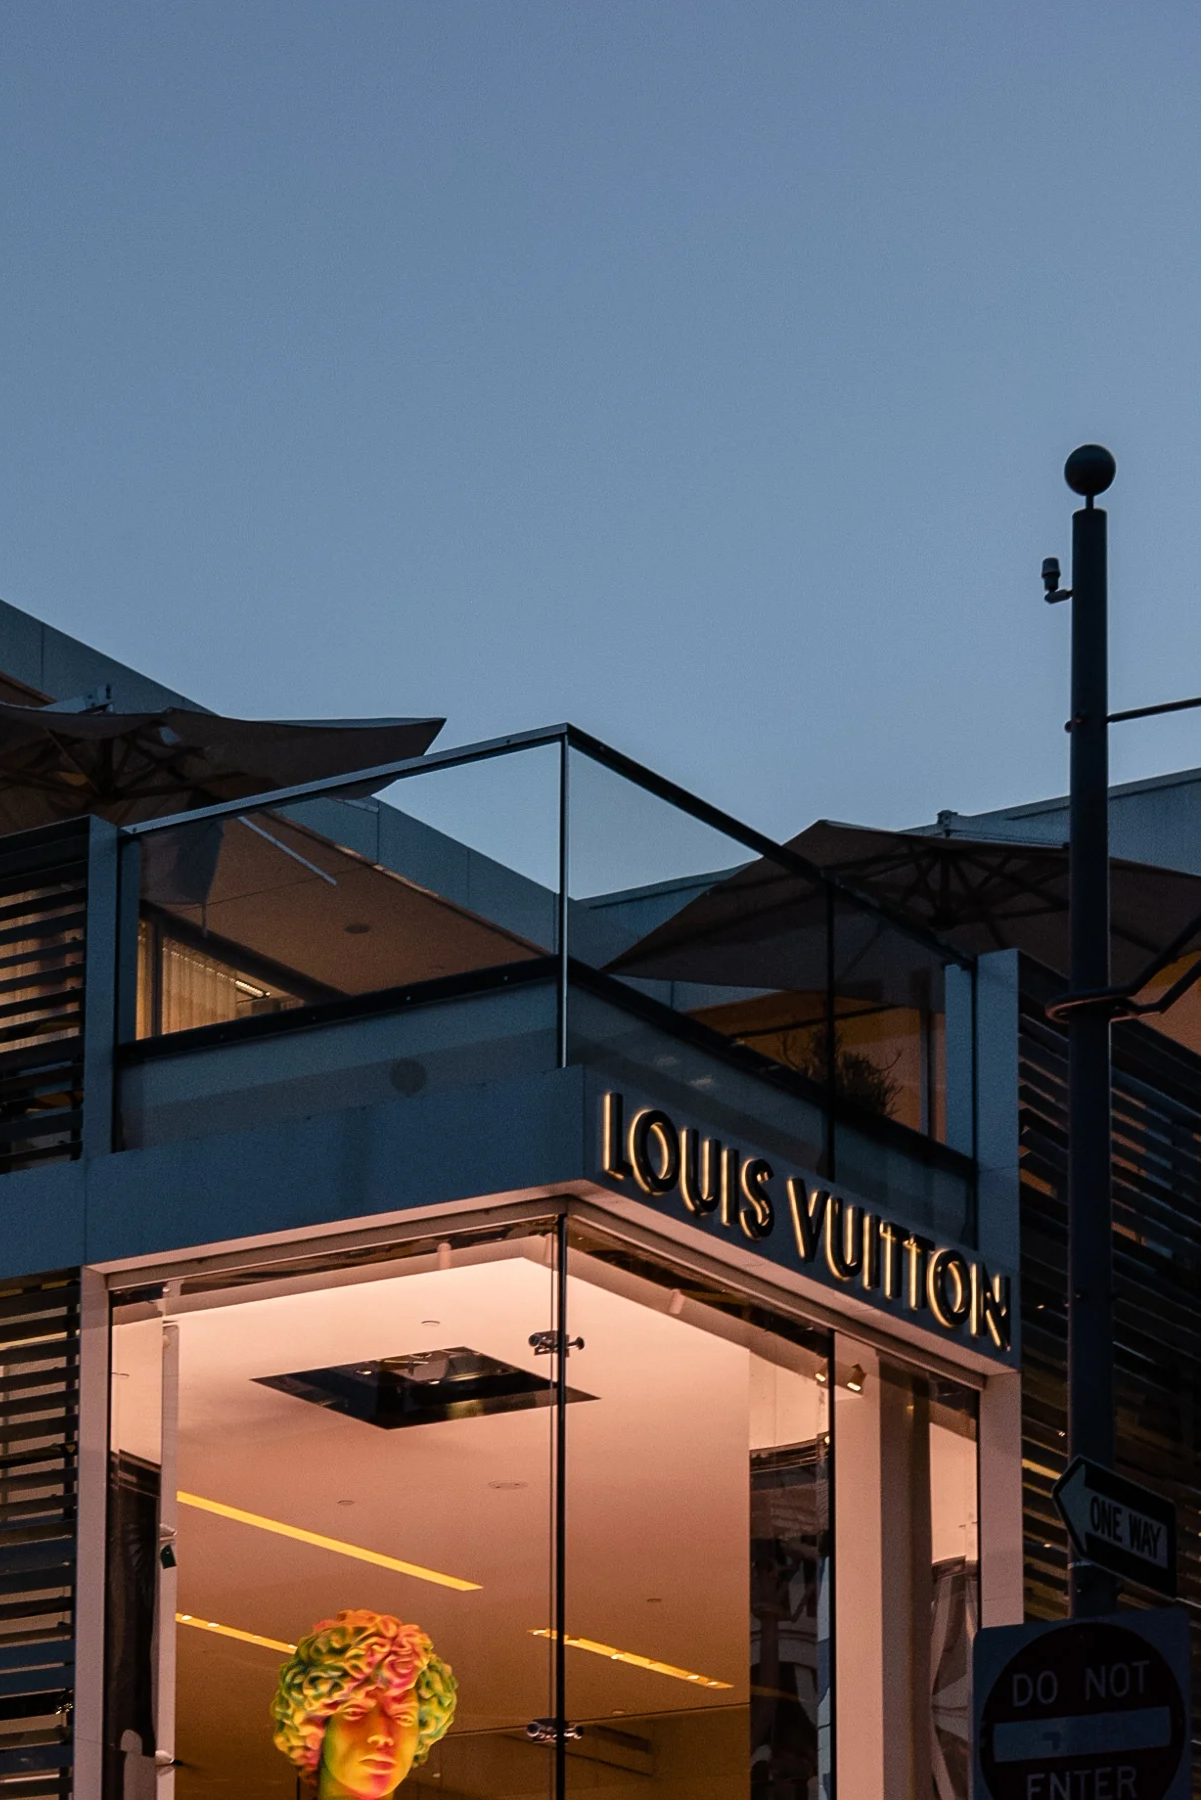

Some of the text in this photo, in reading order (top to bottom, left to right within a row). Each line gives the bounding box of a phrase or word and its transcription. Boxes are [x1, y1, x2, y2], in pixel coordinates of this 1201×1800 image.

[603, 1091, 1011, 1352] LOUIS VUITTON
[1090, 1496, 1161, 1559] ONE WAY
[1011, 1659, 1151, 1708] DO NOT
